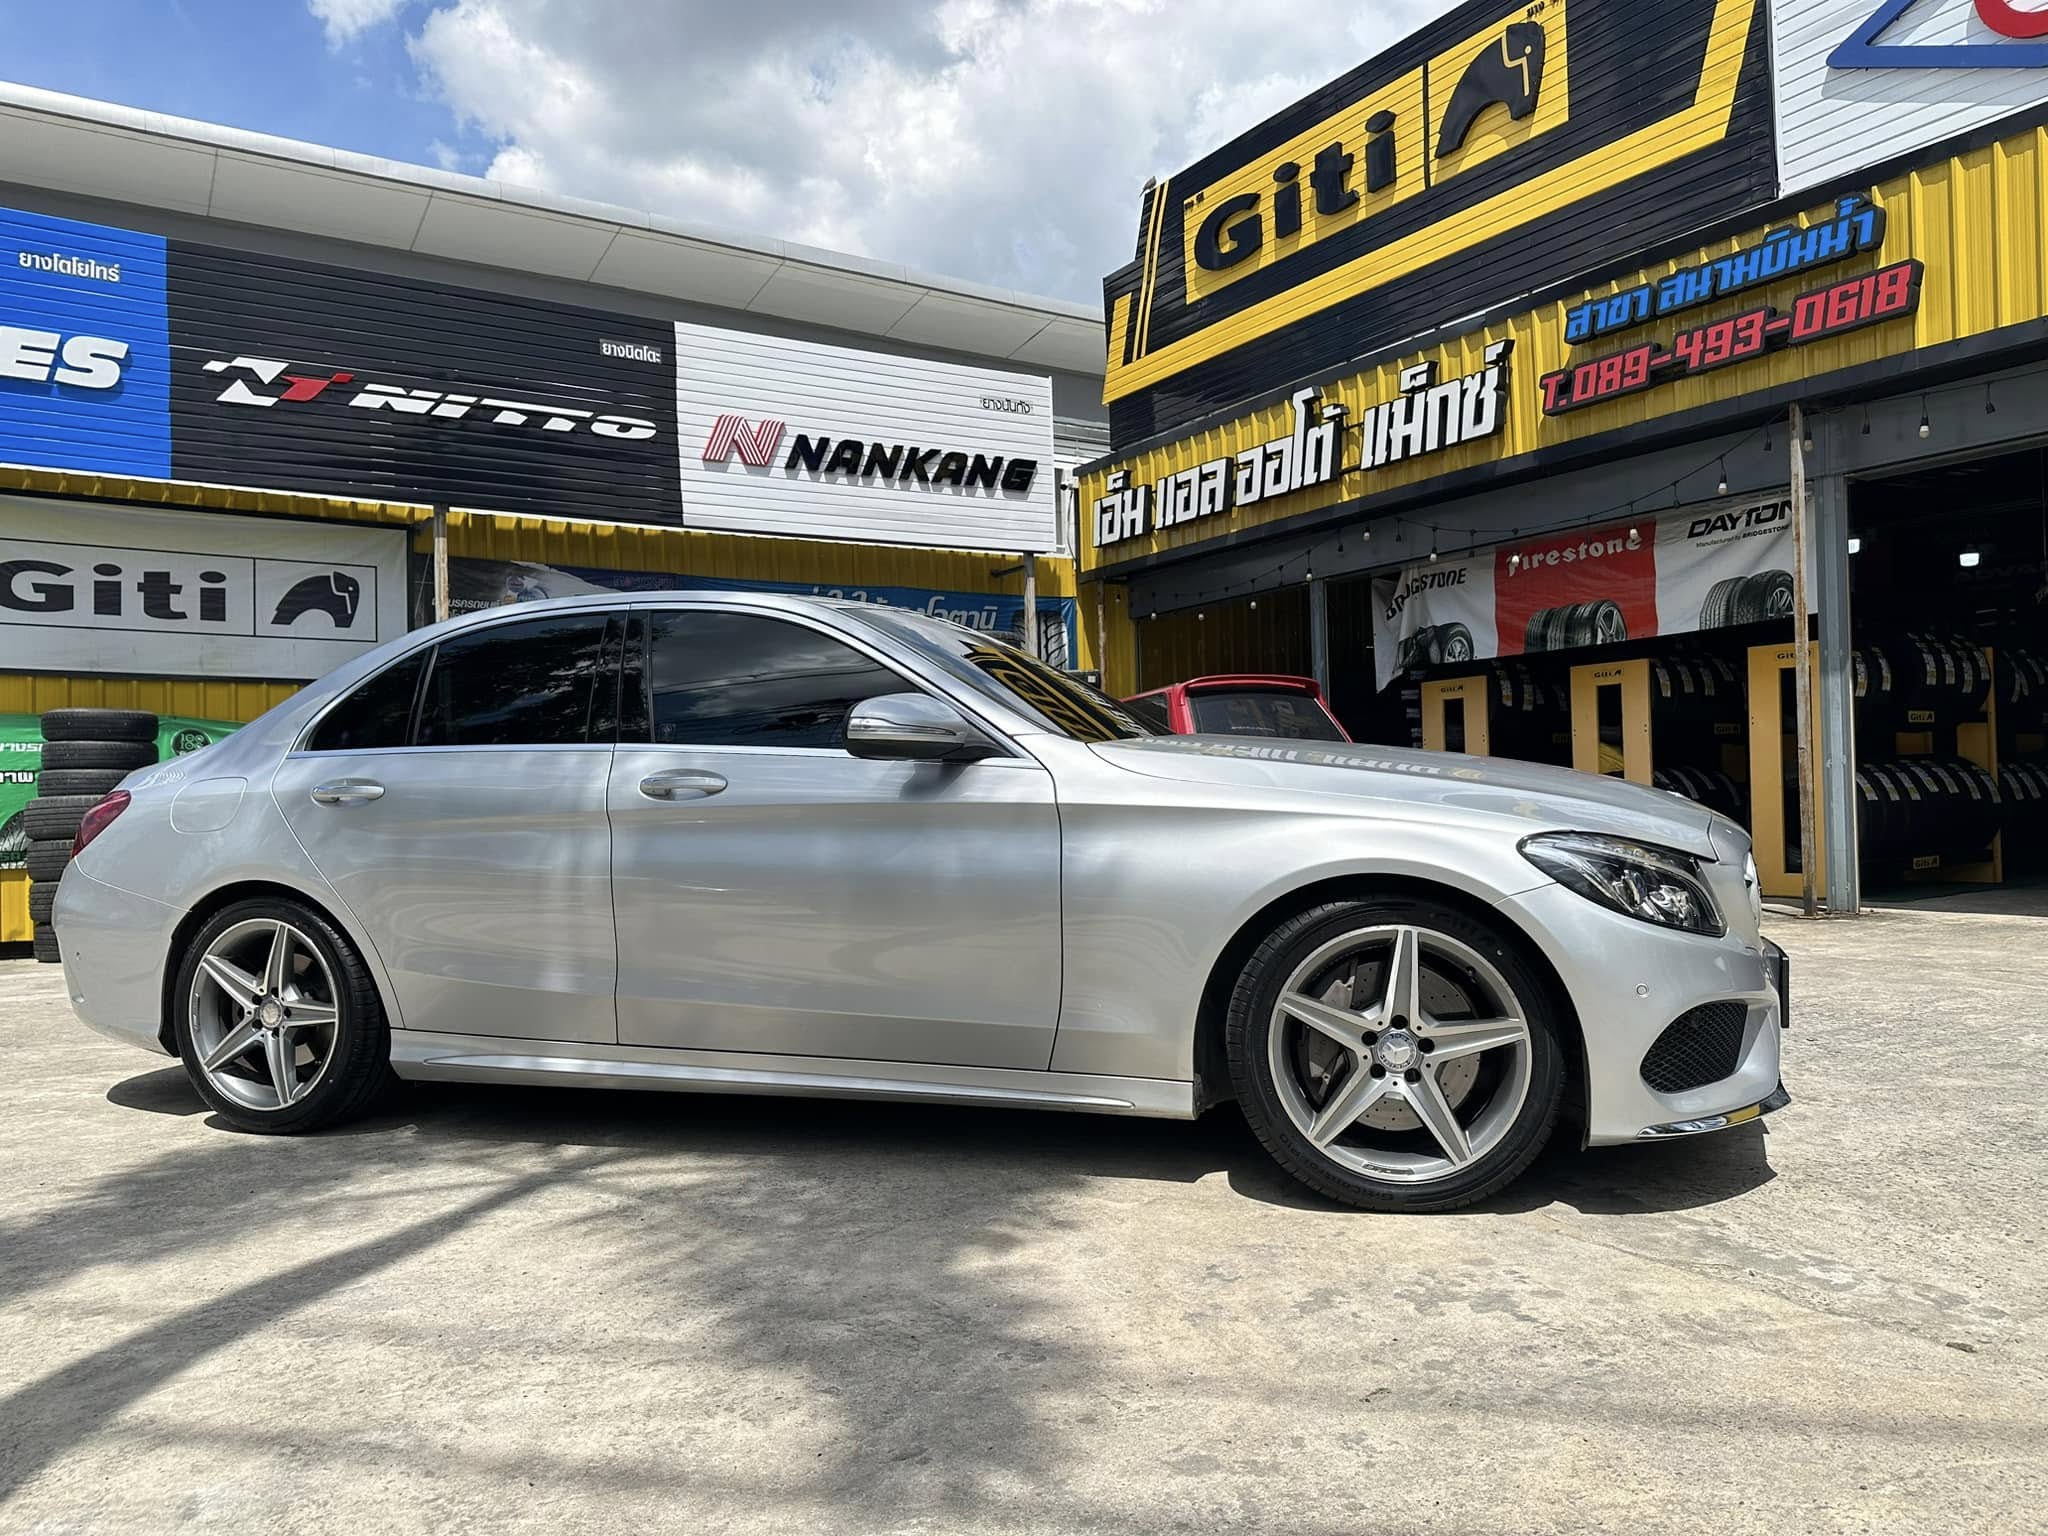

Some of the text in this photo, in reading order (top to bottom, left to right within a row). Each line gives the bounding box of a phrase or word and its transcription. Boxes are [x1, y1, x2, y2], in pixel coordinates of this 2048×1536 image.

[1195, 110, 1397, 271] Giti
[1540, 263, 1913, 411] T.089-493-0618
[1567, 296, 1653, 343] สาขา
[349, 383, 657, 440] NITTO
[784, 433, 1038, 492] NANKANG
[1093, 468, 1148, 547] เอ็ม
[1156, 456, 1230, 530] แอล
[0, 560, 226, 622] Giti
